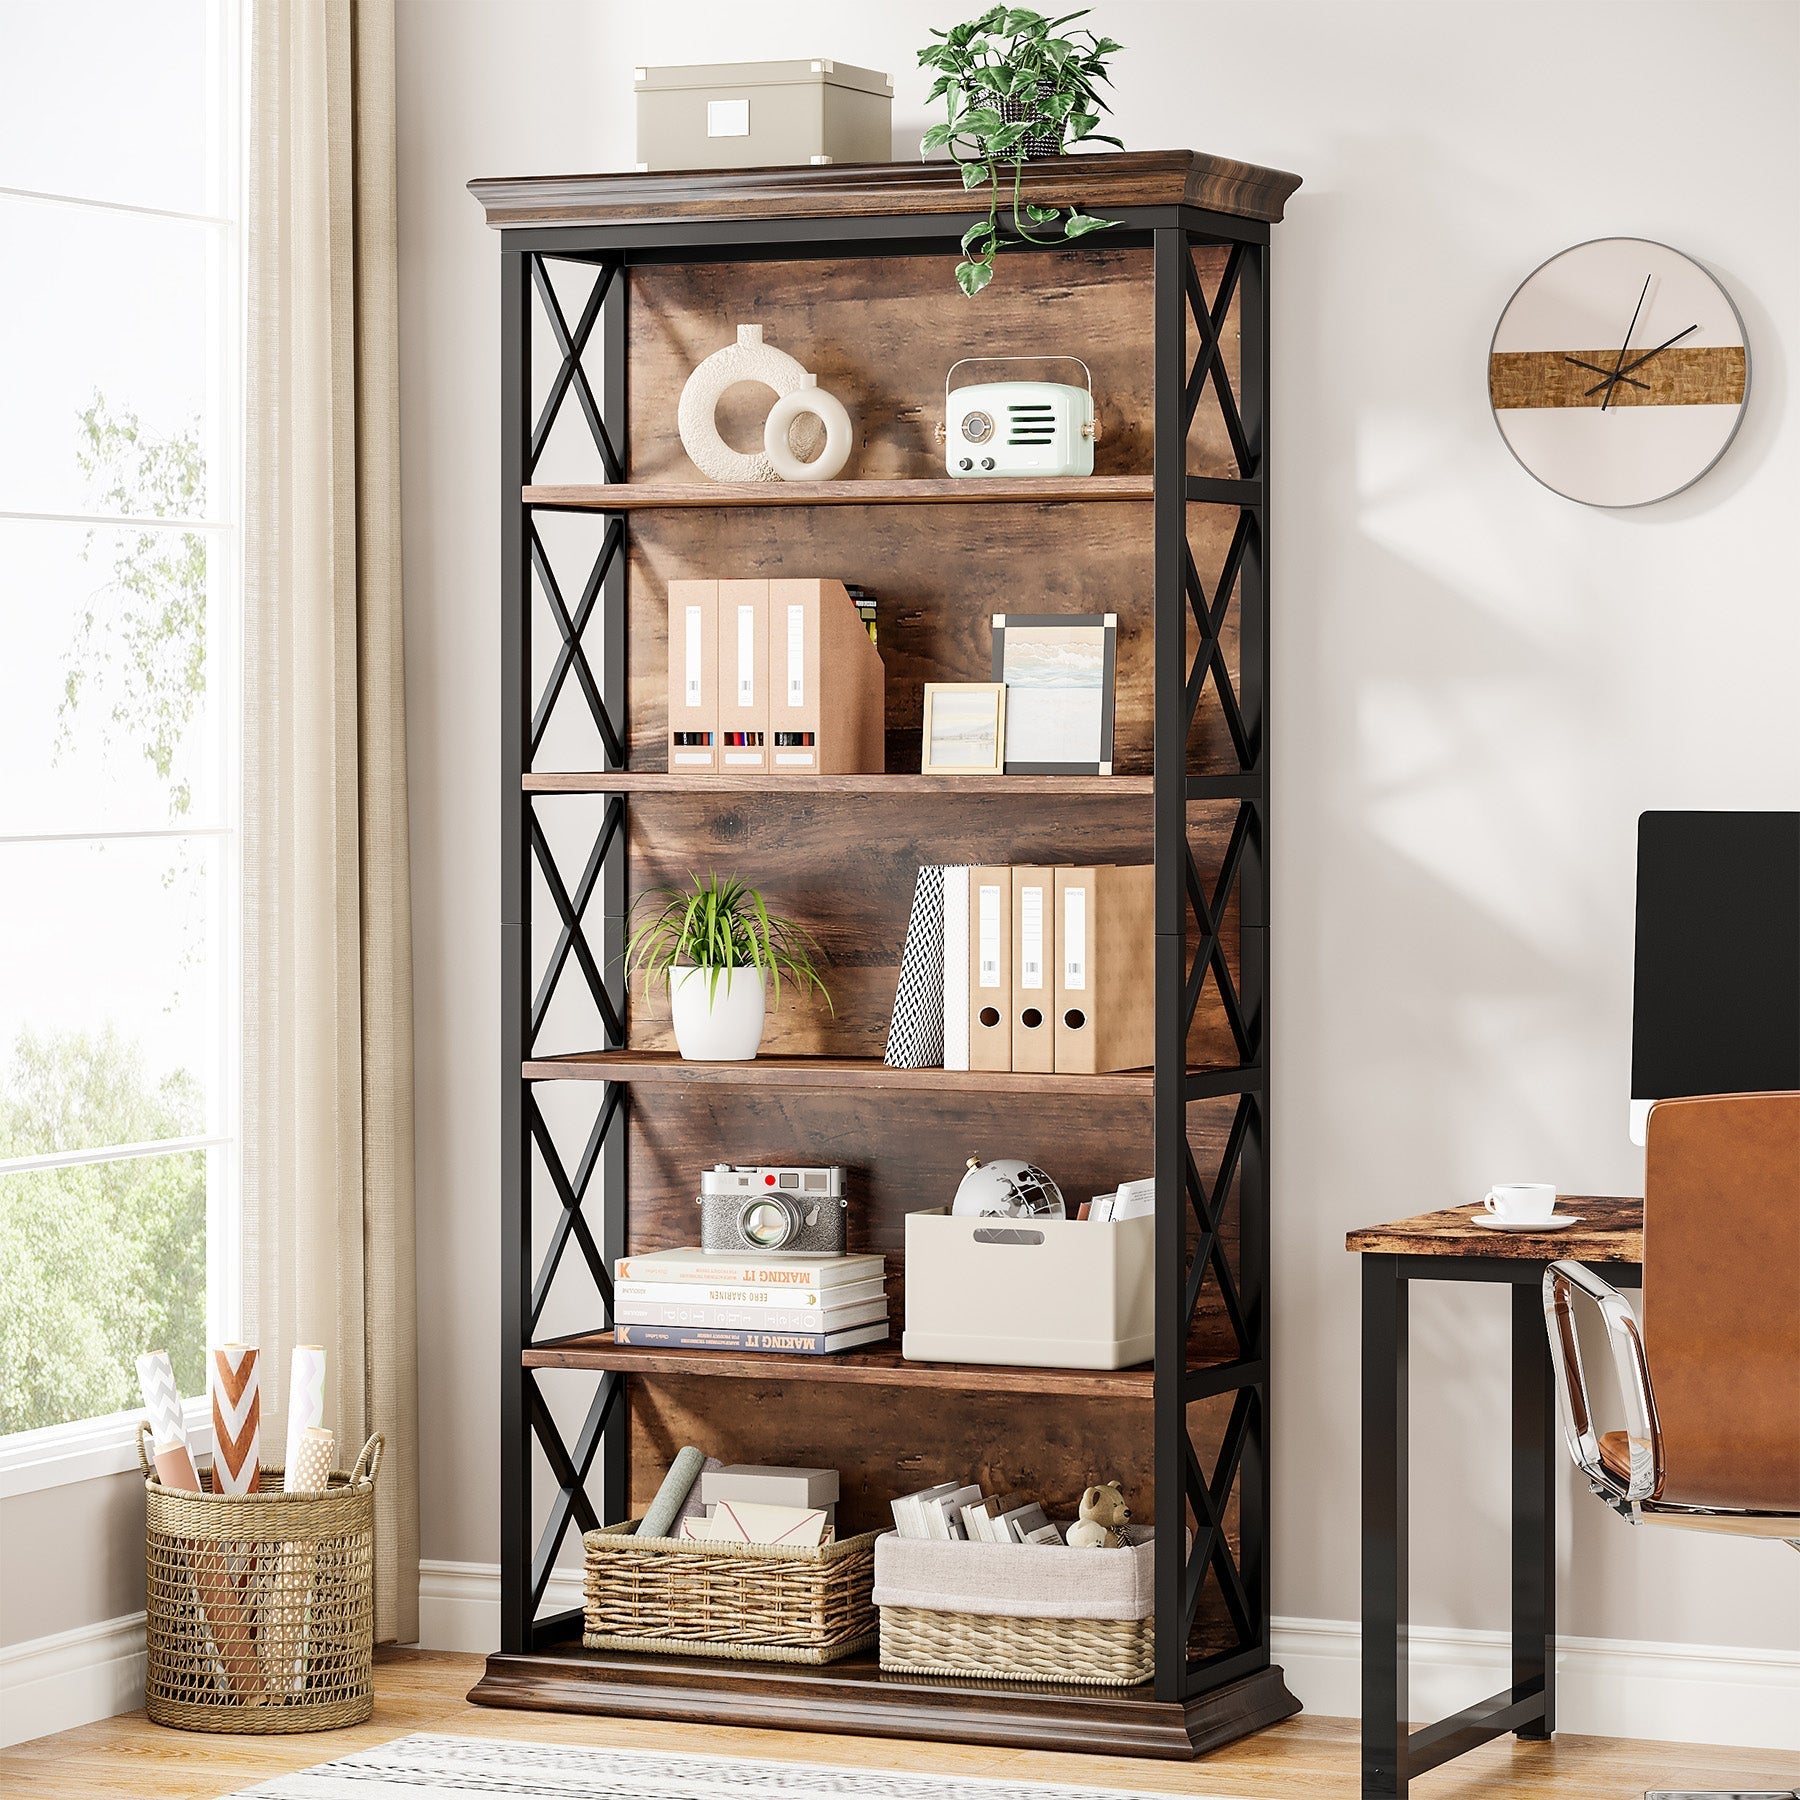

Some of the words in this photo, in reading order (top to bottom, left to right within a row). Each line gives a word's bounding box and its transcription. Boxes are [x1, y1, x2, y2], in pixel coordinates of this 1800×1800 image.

[743, 1270, 756, 1281] IT
[759, 1270, 810, 1284] MAKING
[709, 1290, 747, 1301] SAARINEN
[749, 1292, 768, 1302] EERO
[745, 1334, 760, 1347] IT
[762, 1335, 816, 1350] MAKING
